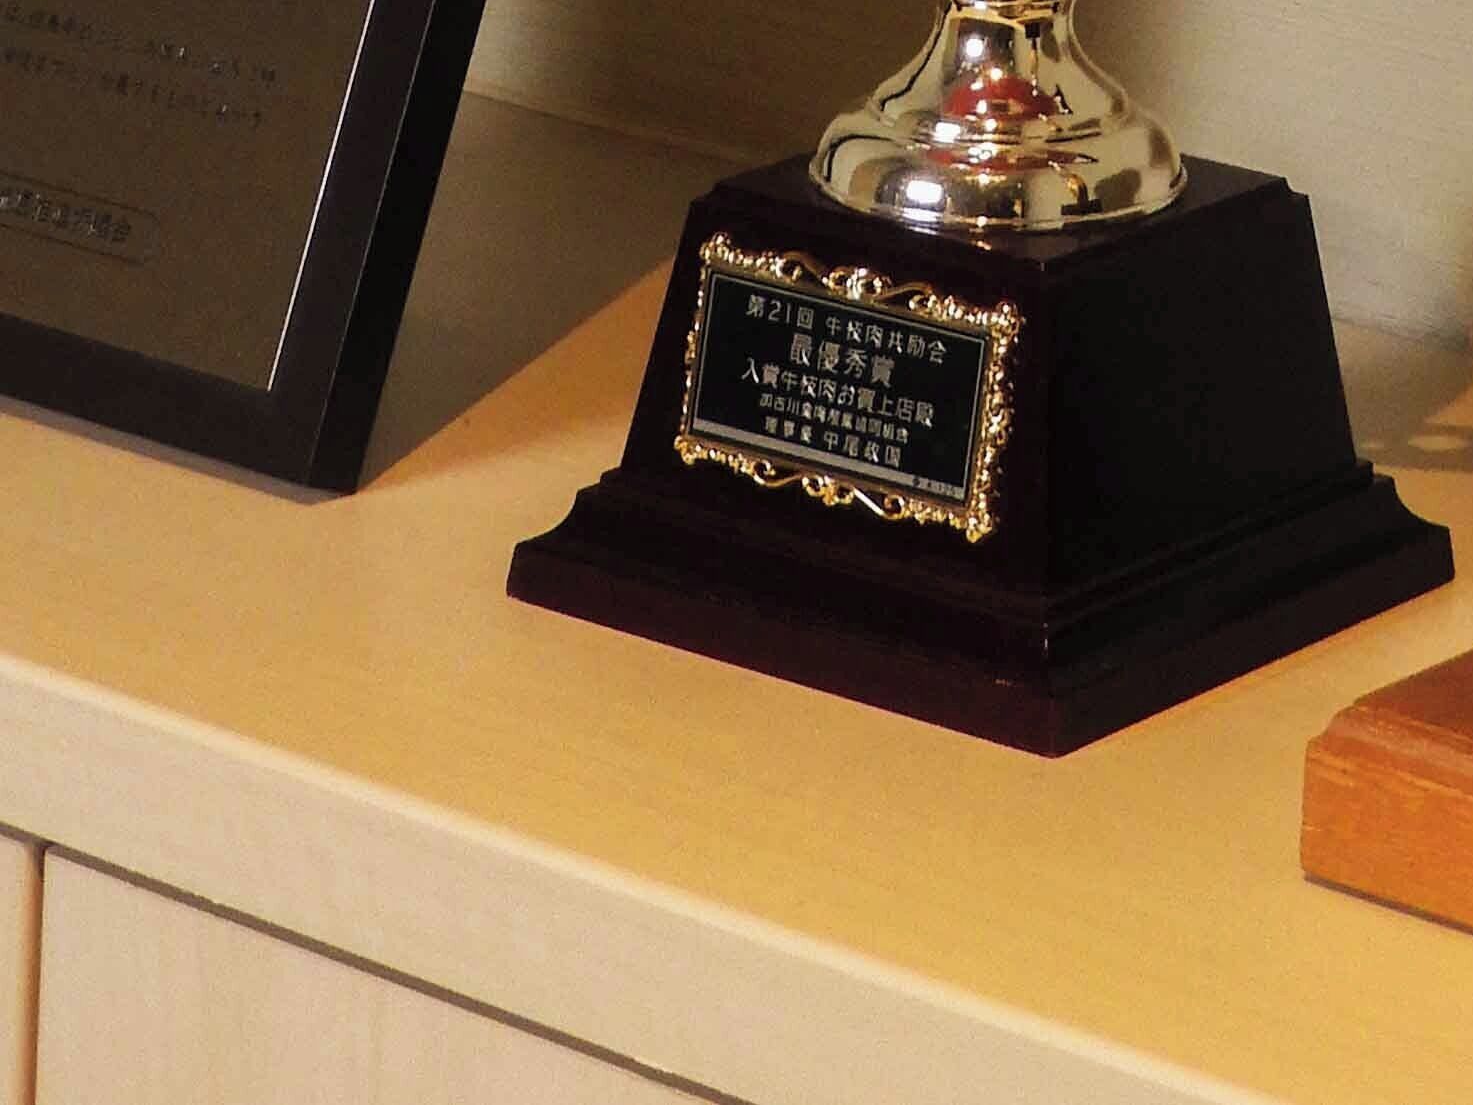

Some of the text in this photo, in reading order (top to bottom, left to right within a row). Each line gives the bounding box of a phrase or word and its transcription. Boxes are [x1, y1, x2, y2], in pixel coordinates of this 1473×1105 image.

[745, 294, 946, 363] 第21回 牛枝肉共励会
[791, 333, 895, 387] 最優秀賞
